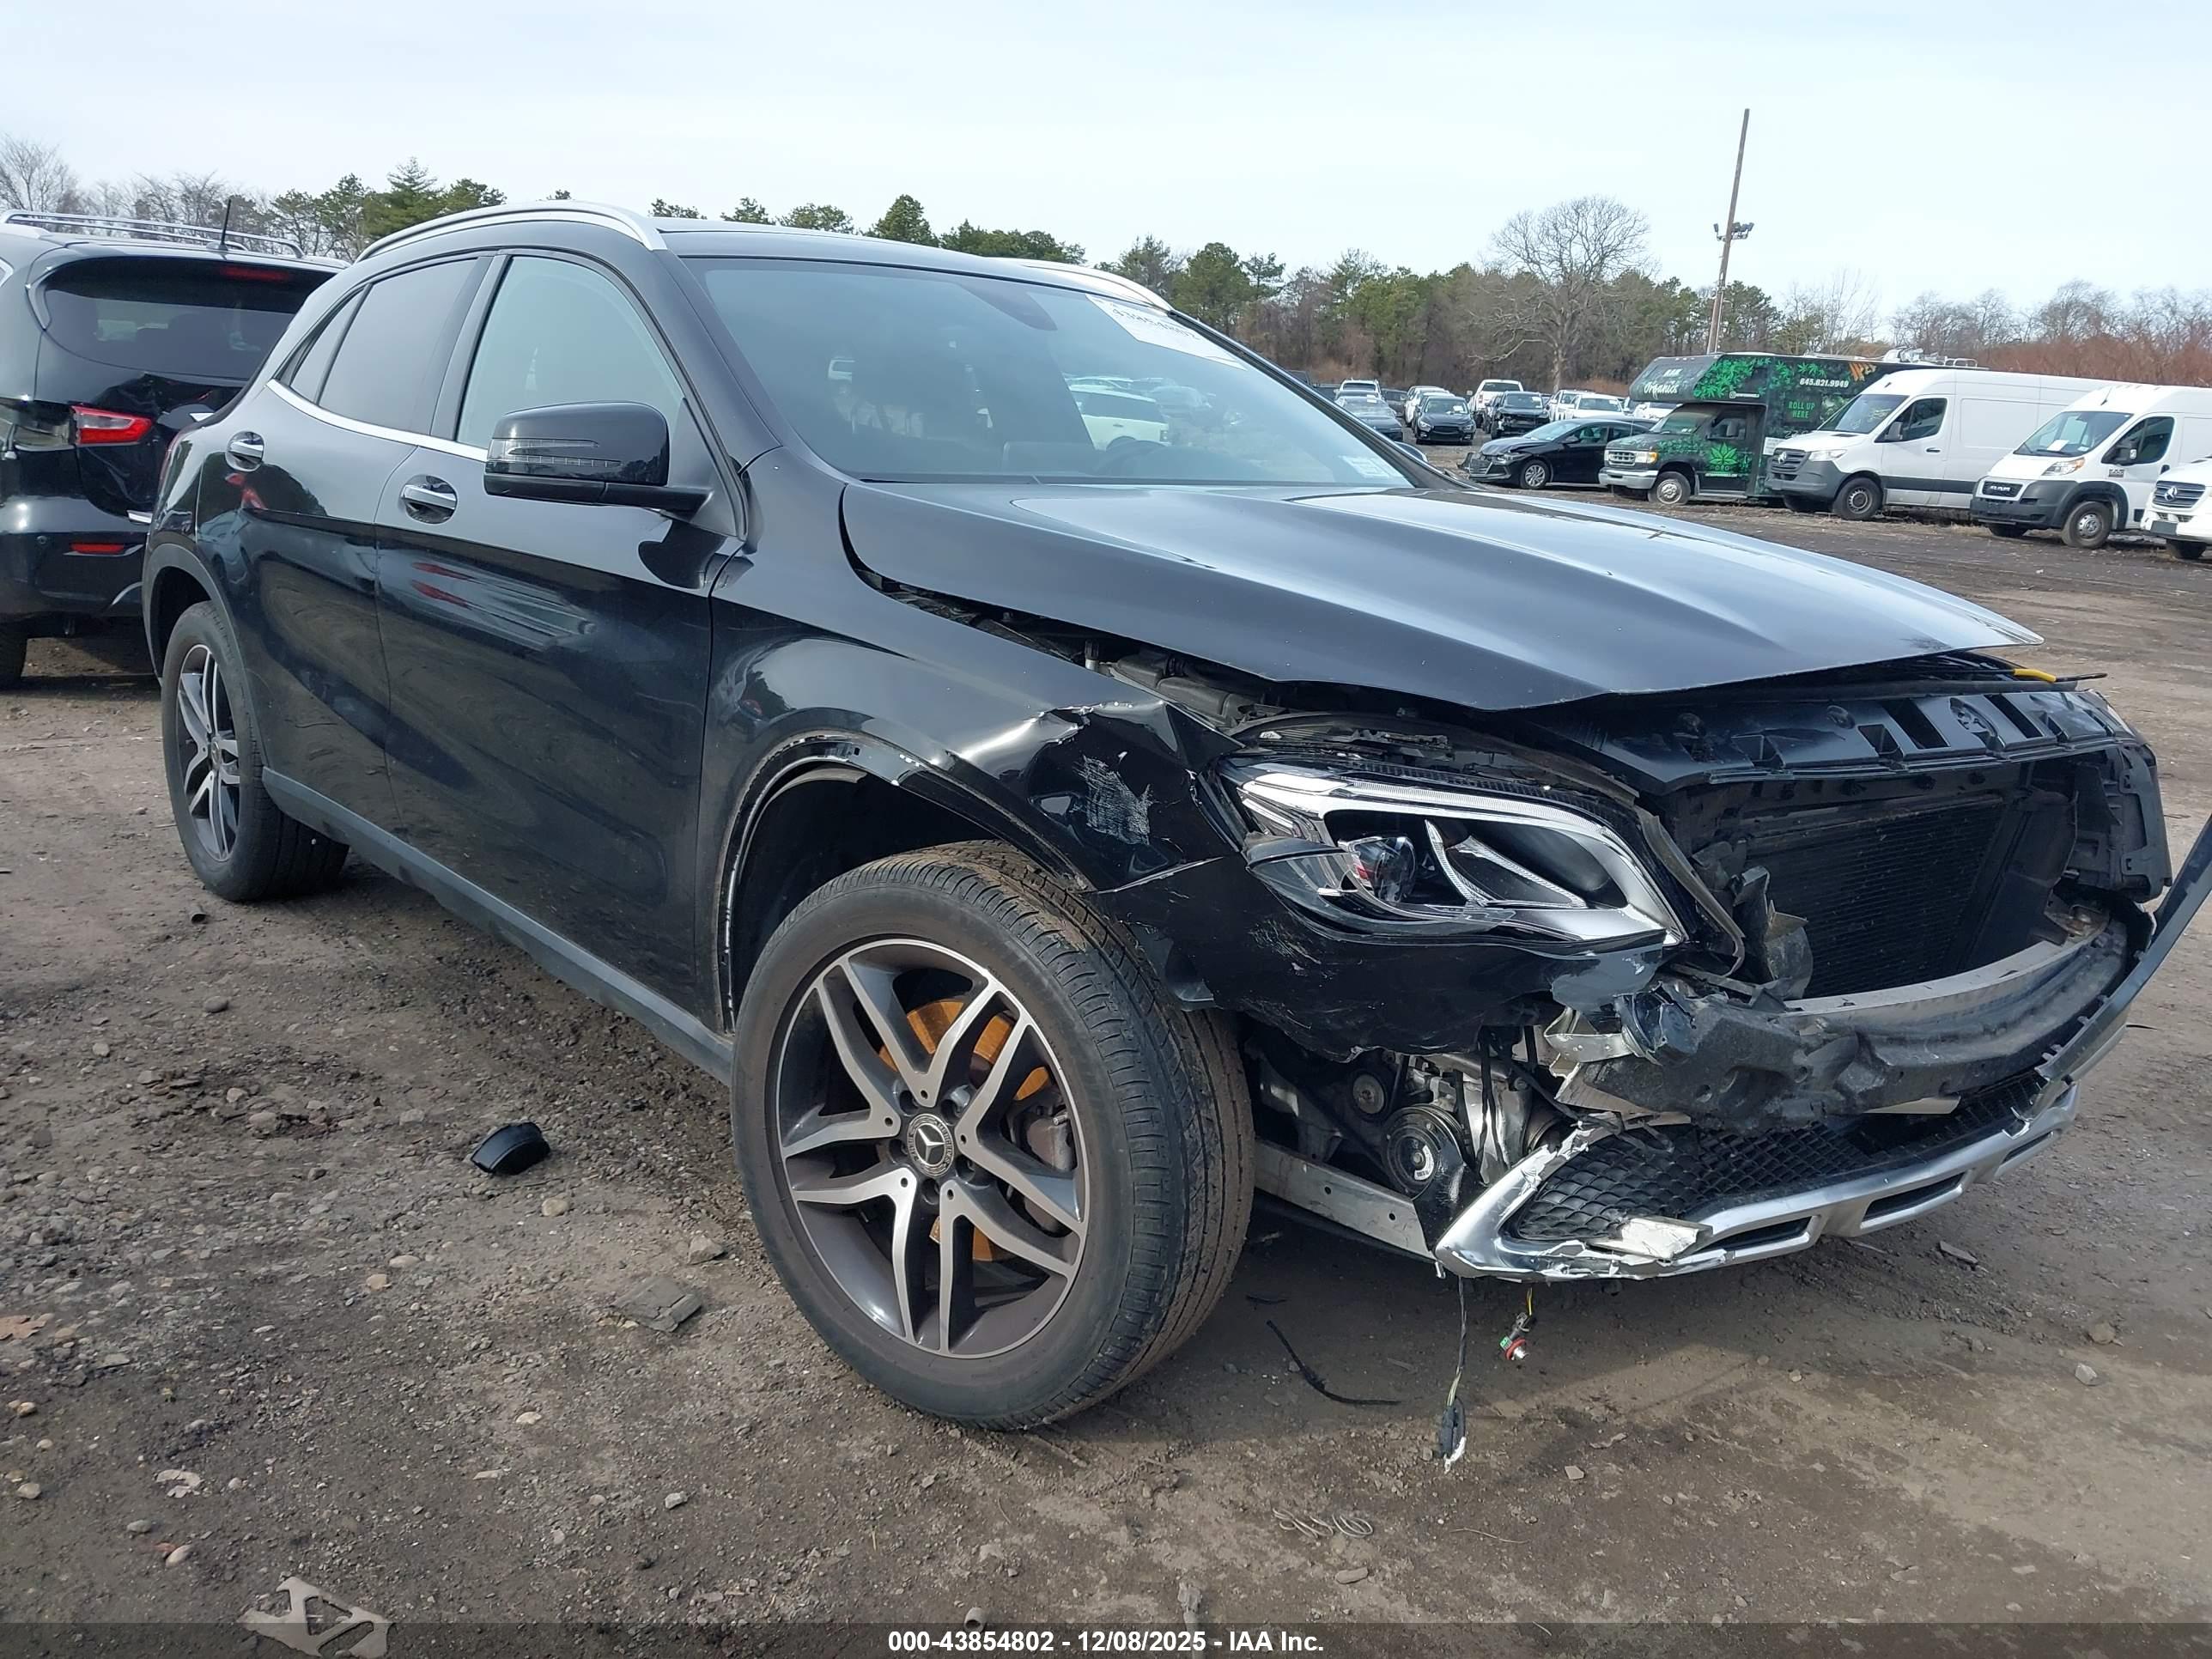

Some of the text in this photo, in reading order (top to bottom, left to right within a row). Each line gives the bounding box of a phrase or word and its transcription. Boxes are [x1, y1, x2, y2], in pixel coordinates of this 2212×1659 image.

[1644, 380, 1680, 400] Organics
[1789, 401, 1815, 410] ROLL UP
[1792, 410, 1809, 419] HERE
